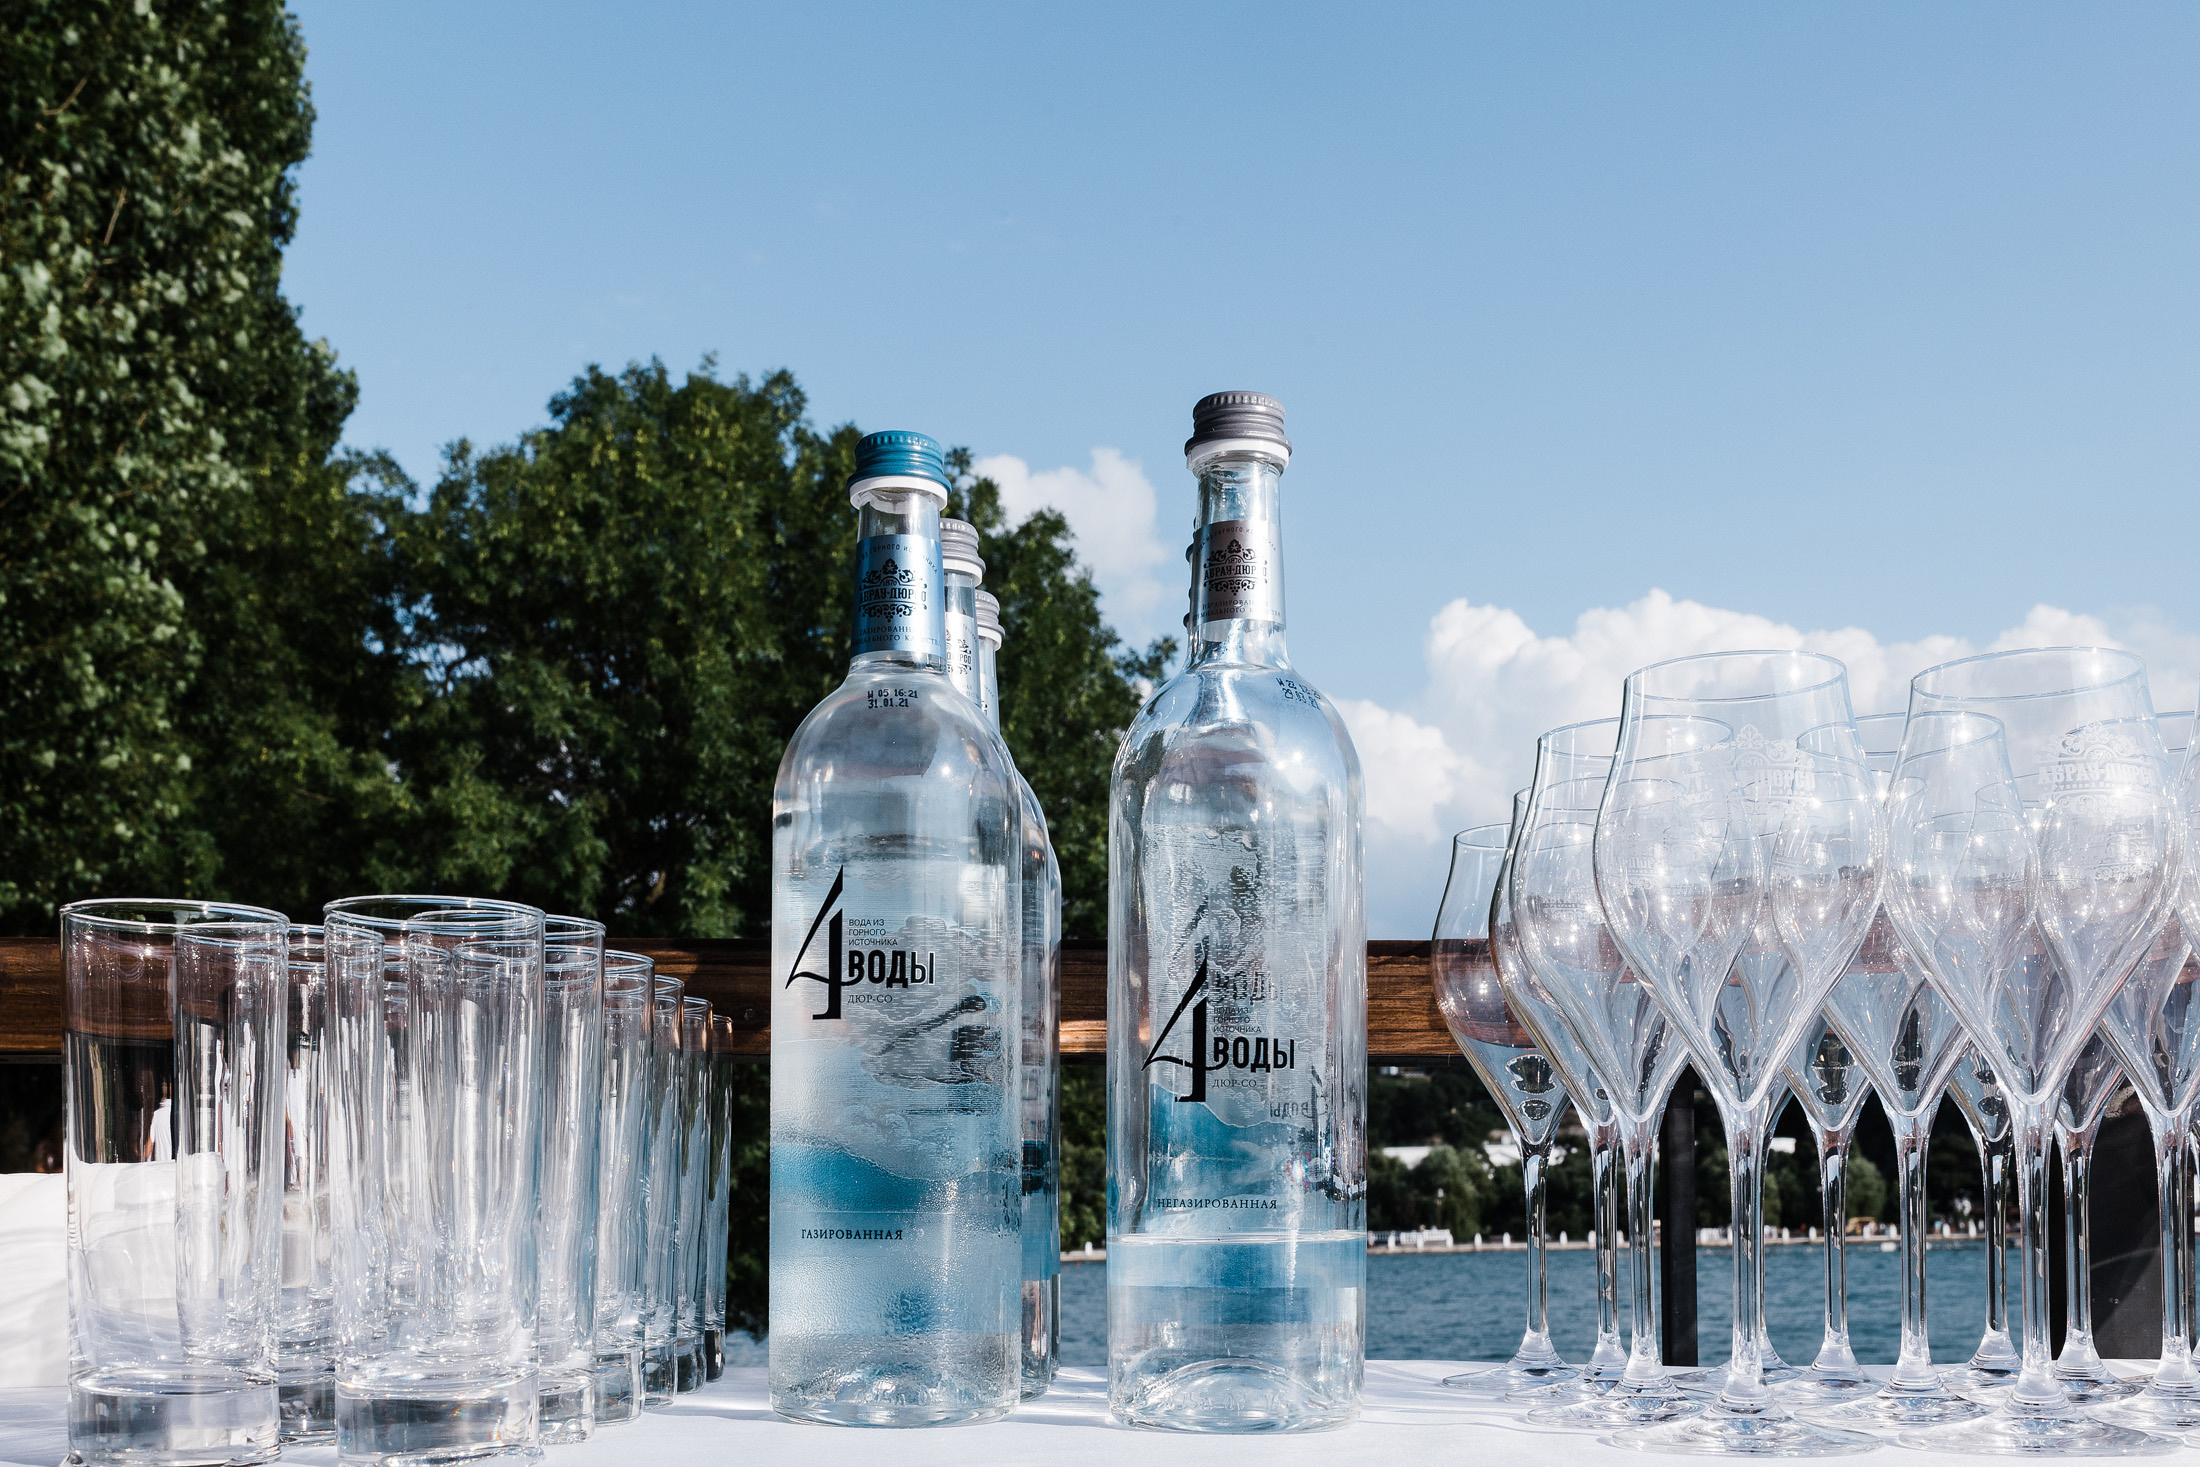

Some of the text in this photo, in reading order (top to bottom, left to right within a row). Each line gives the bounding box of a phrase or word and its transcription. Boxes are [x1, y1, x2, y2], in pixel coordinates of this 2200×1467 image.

[1204, 564, 1267, 580] АБРАУ-ДЮРО
[860, 587, 927, 603] АБРАУ-ДЮРО
[877, 689, 889, 697] 05
[894, 688, 918, 698] 16:21
[867, 697, 909, 709] 31.01.21
[848, 918, 885, 927] ВОДА ИЗ
[848, 928, 887, 937] ГОРНОГО
[785, 864, 936, 1021] 4 ВОДЫ
[848, 938, 899, 947] ИСТОЧНИКА
[847, 994, 894, 1005] ДЮР-СО
[1237, 1006, 1249, 1015] ИЗ
[1213, 1016, 1251, 1024] ГОРНОГО
[1213, 1025, 1262, 1033] ИСТОЧНИКА
[1213, 1036, 1295, 1074] ВОДЫ
[1212, 1078, 1257, 1089] ДЮР-СО
[1157, 1198, 1278, 1210] НЕГАЗИРОВАННАЯ
[801, 1229, 903, 1241] ГАЗИРОВАННАЯ
